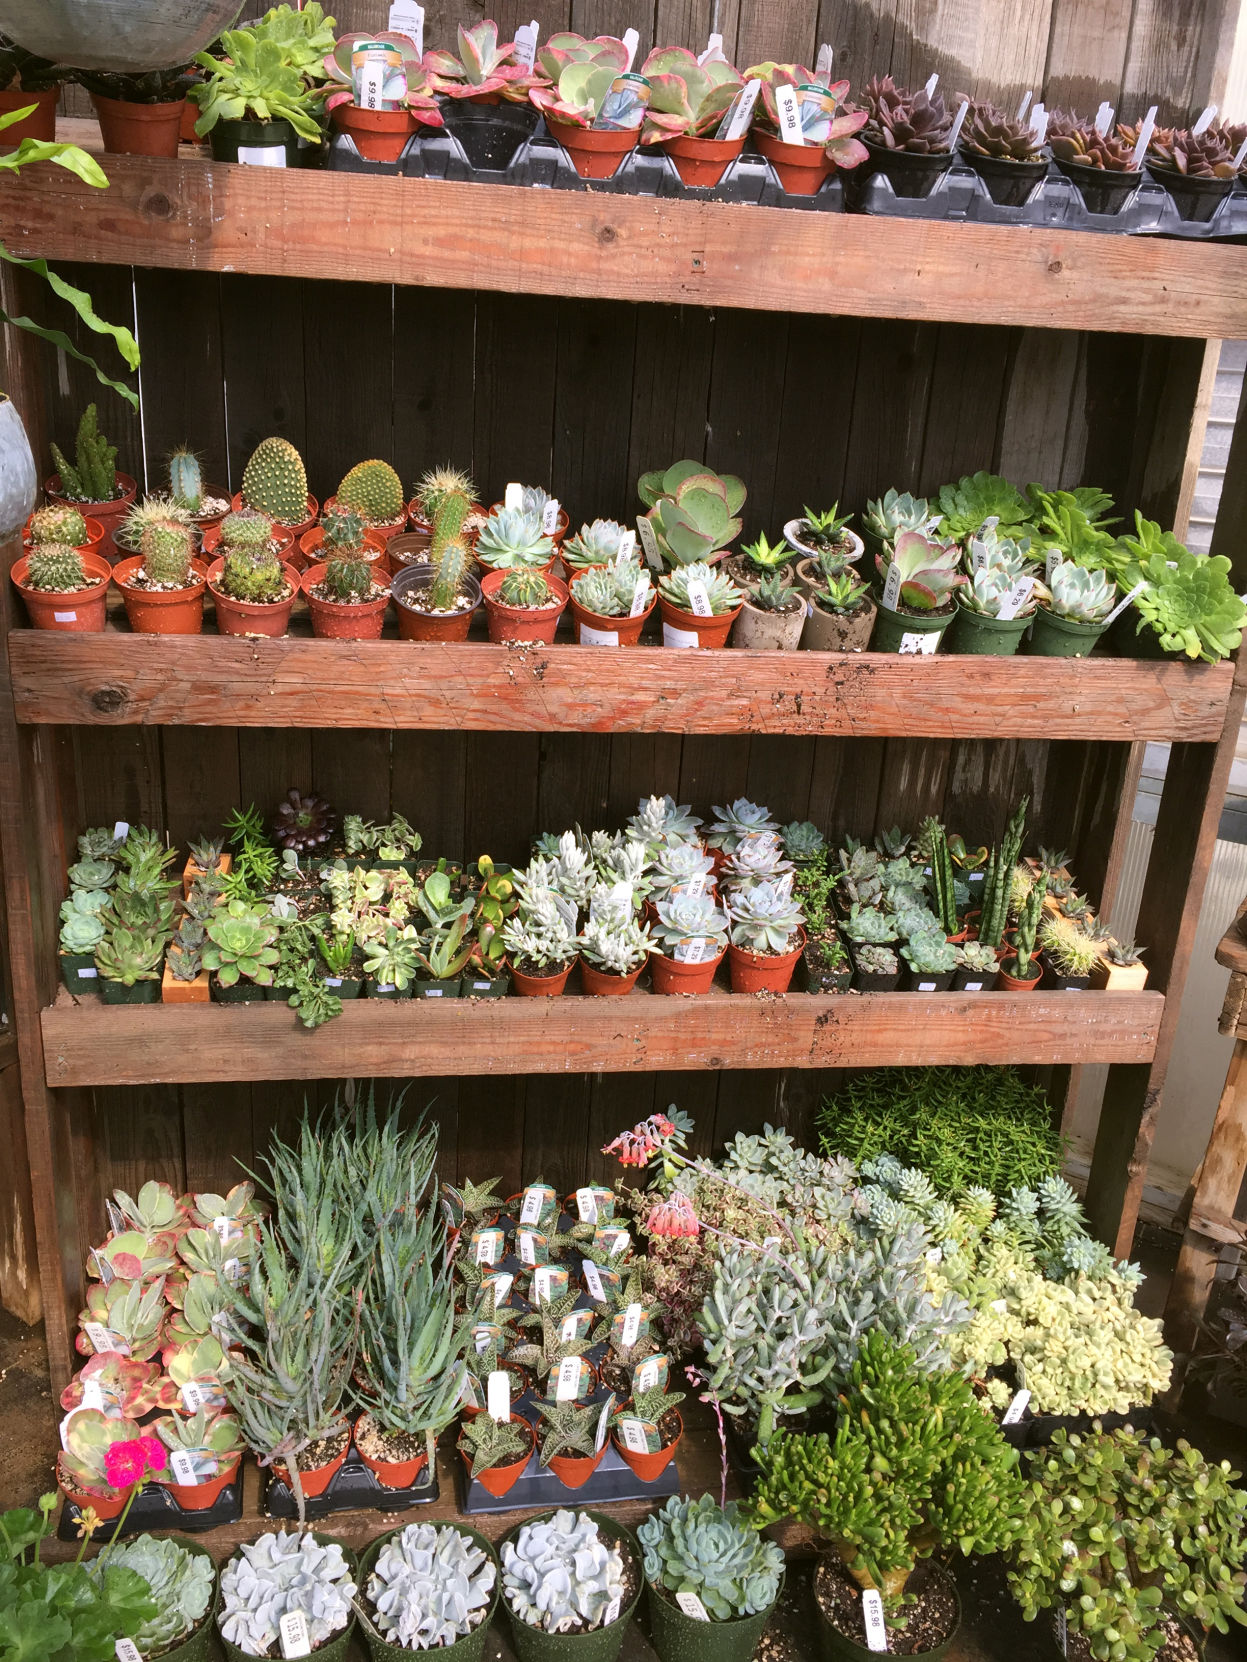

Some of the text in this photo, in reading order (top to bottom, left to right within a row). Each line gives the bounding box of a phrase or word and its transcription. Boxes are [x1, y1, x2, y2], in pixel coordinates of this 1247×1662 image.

[367, 81, 377, 109] $9.98
[783, 99, 796, 129] $9.98
[886, 570, 898, 601] $6.98
[694, 594, 706, 615] $8.98
[869, 1599, 881, 1628] $15.98
[286, 1616, 301, 1645] $15.98
